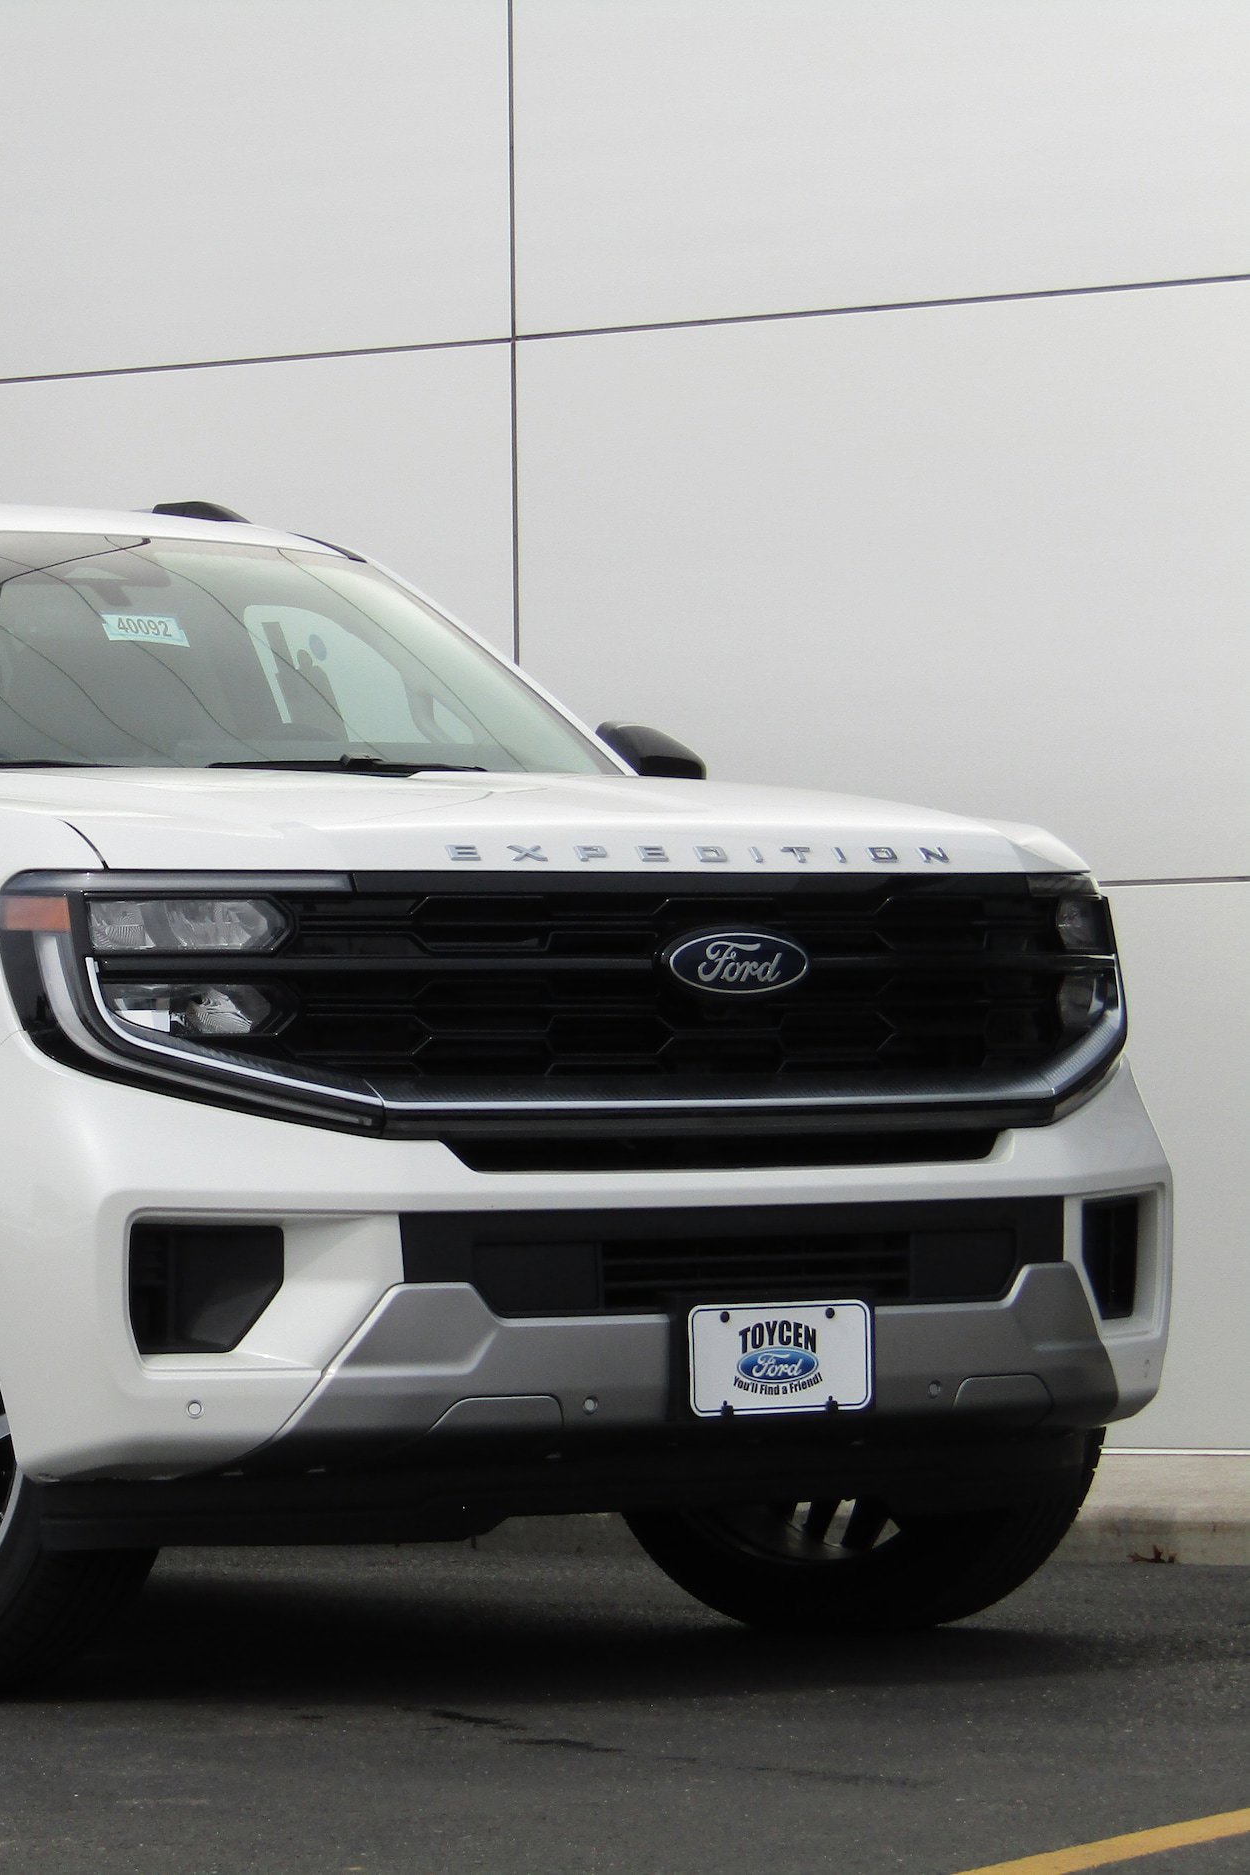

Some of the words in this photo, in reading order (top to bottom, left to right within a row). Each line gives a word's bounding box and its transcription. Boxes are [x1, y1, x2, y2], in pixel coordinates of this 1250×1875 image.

[117, 617, 172, 637] 40092
[444, 845, 949, 863] EXPEDITION
[697, 941, 783, 983] Ford
[738, 1320, 817, 1354] TOYCEN
[752, 1352, 802, 1377] Ford
[759, 1383, 780, 1395] Find
[781, 1385, 788, 1395] a
